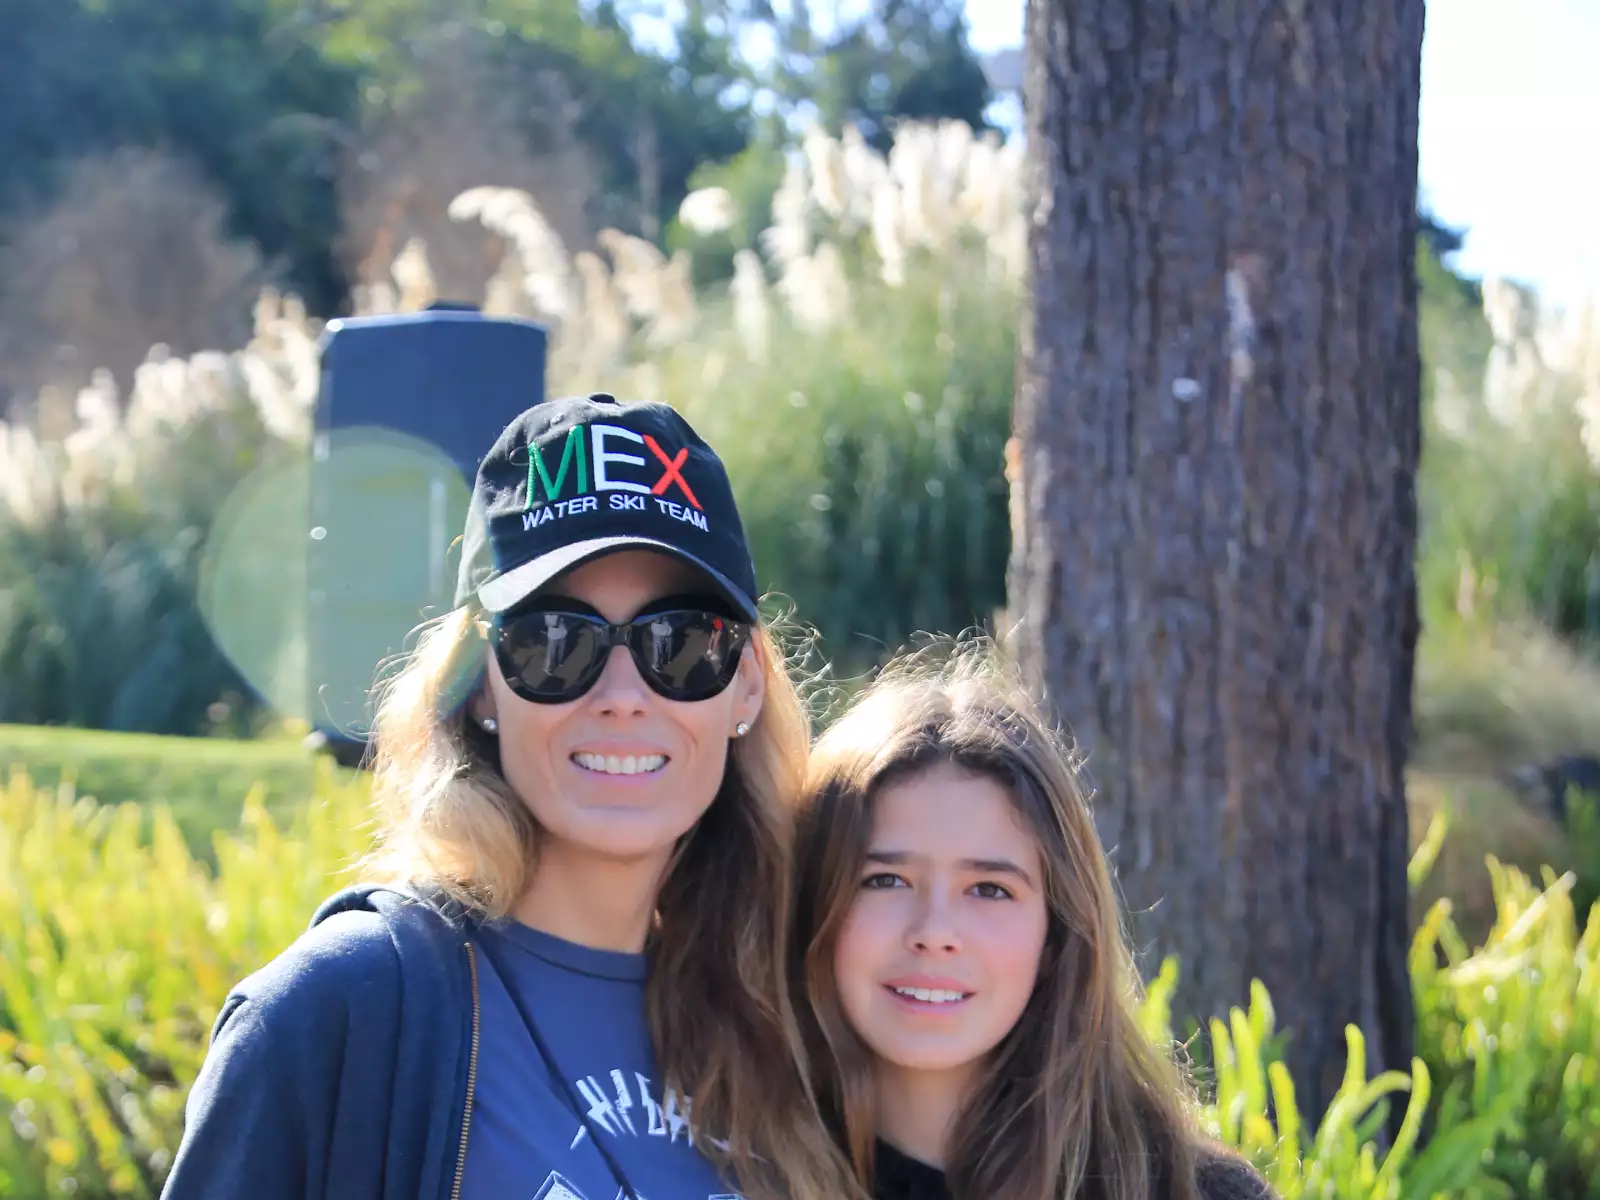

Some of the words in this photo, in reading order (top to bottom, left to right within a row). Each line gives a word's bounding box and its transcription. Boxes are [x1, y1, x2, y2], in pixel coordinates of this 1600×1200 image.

[523, 423, 704, 512] MEX
[521, 496, 599, 532] WATER
[608, 494, 646, 511] SKI
[653, 497, 711, 533] TEAM
